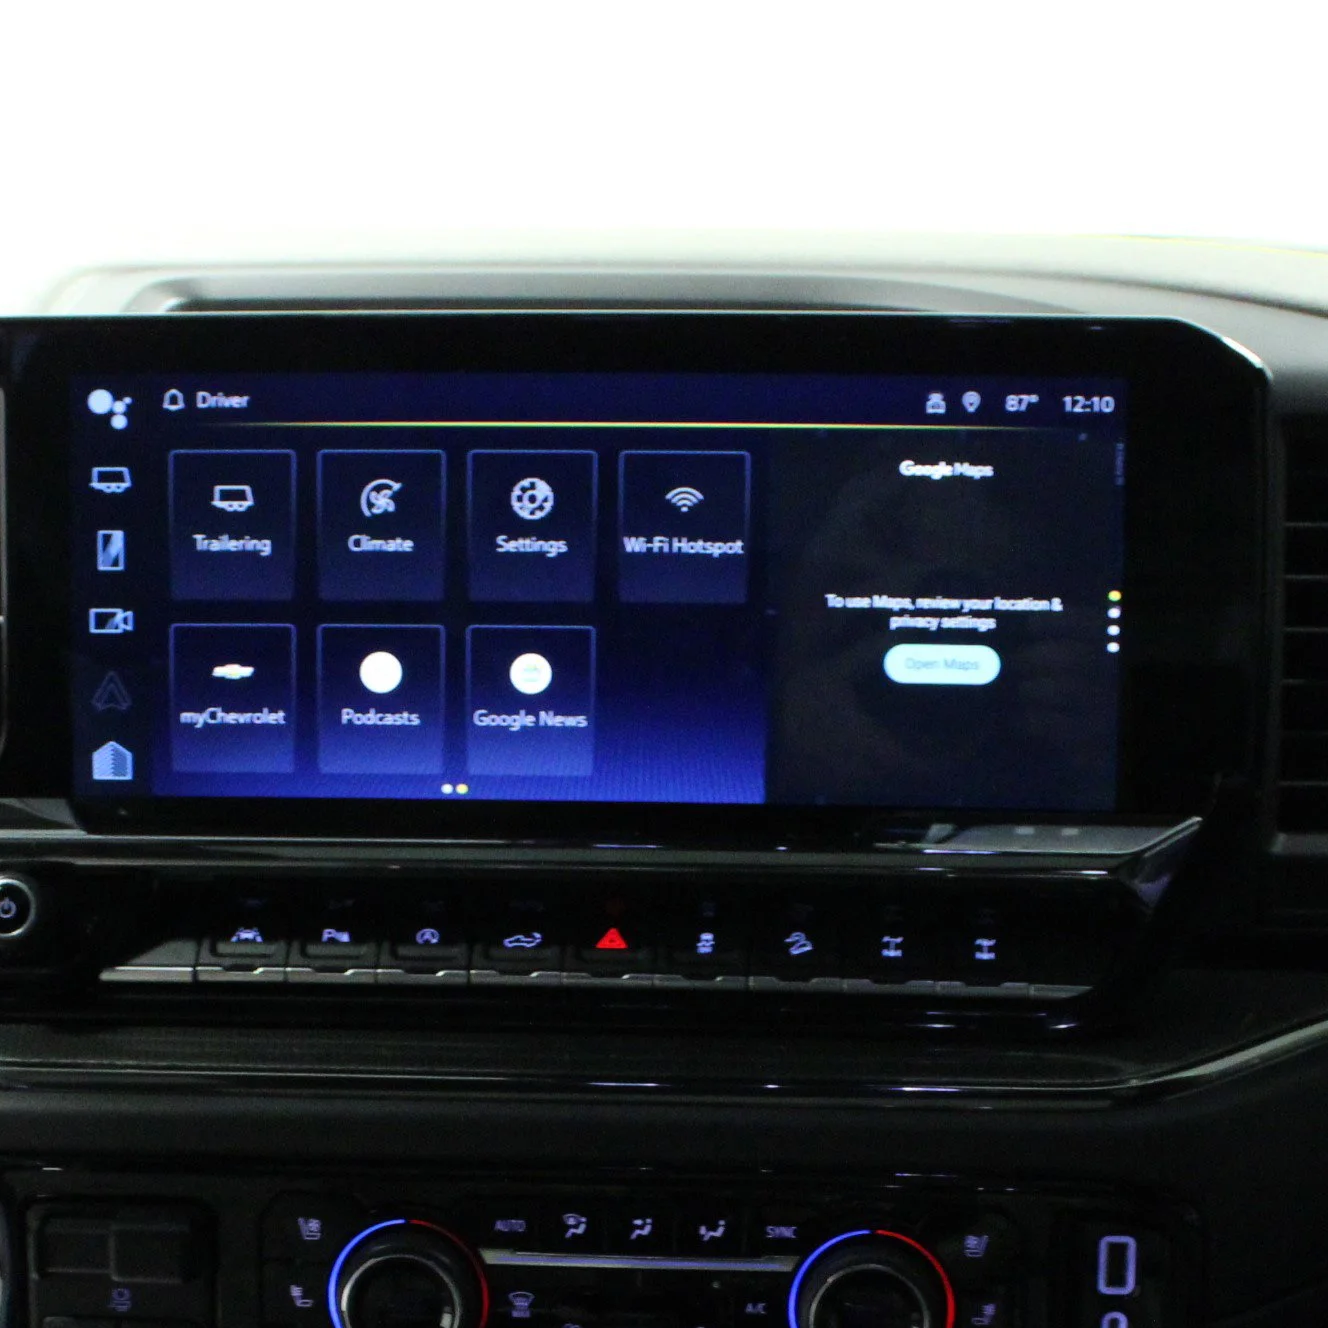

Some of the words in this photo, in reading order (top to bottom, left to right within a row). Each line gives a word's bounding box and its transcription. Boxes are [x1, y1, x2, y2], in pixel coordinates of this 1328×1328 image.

[196, 391, 250, 409] Driver
[1005, 394, 1039, 412] 87°
[1063, 396, 1115, 413] 12:10
[899, 460, 953, 480] Google
[954, 462, 994, 479] Maps
[192, 534, 272, 556] Trailering
[347, 534, 414, 552] Climate
[496, 535, 568, 557] Settings
[623, 536, 669, 553] Wi-Fi
[672, 537, 744, 557] Hotspot
[825, 593, 845, 608] To
[845, 597, 872, 608] use
[961, 599, 994, 612] your
[994, 596, 1050, 611] location
[1051, 597, 1063, 611] &
[889, 614, 940, 630] privacy
[941, 615, 996, 632] settings
[905, 657, 940, 671] Open
[943, 657, 980, 671] Maps
[180, 707, 285, 728] myChevrolet
[341, 708, 420, 726] Podcasts
[473, 709, 536, 731] Google
[539, 710, 588, 728] News
[494, 1219, 526, 1232] AUTO
[765, 1226, 797, 1239] SYNC
